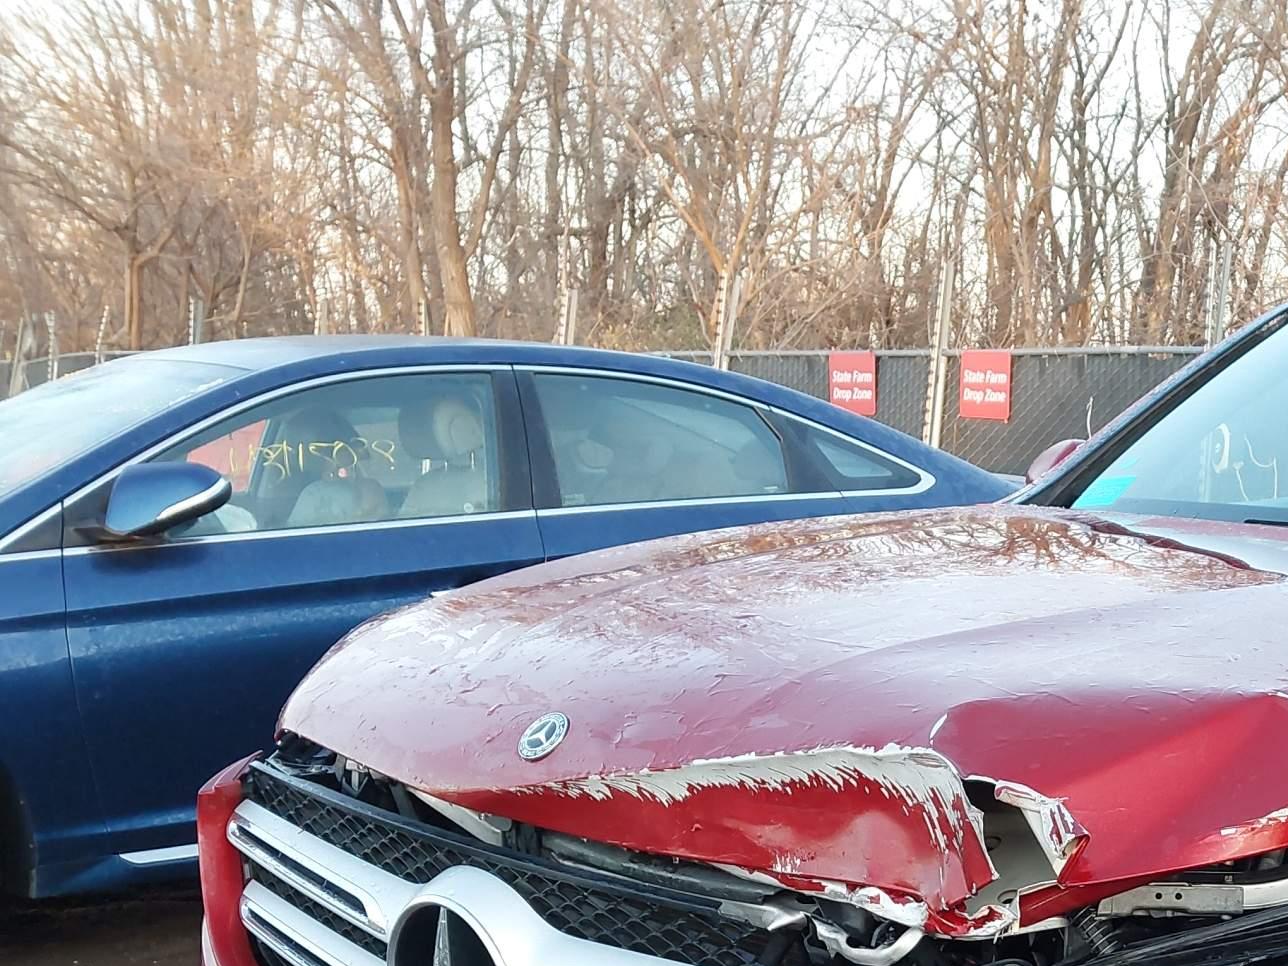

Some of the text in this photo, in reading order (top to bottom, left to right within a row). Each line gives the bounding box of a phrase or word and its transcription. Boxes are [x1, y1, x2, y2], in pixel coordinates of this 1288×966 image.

[832, 370, 873, 384] State Farm
[963, 369, 1007, 384] State Farm
[833, 387, 873, 402] Drop Zone
[963, 387, 1007, 405] Drop Zone
